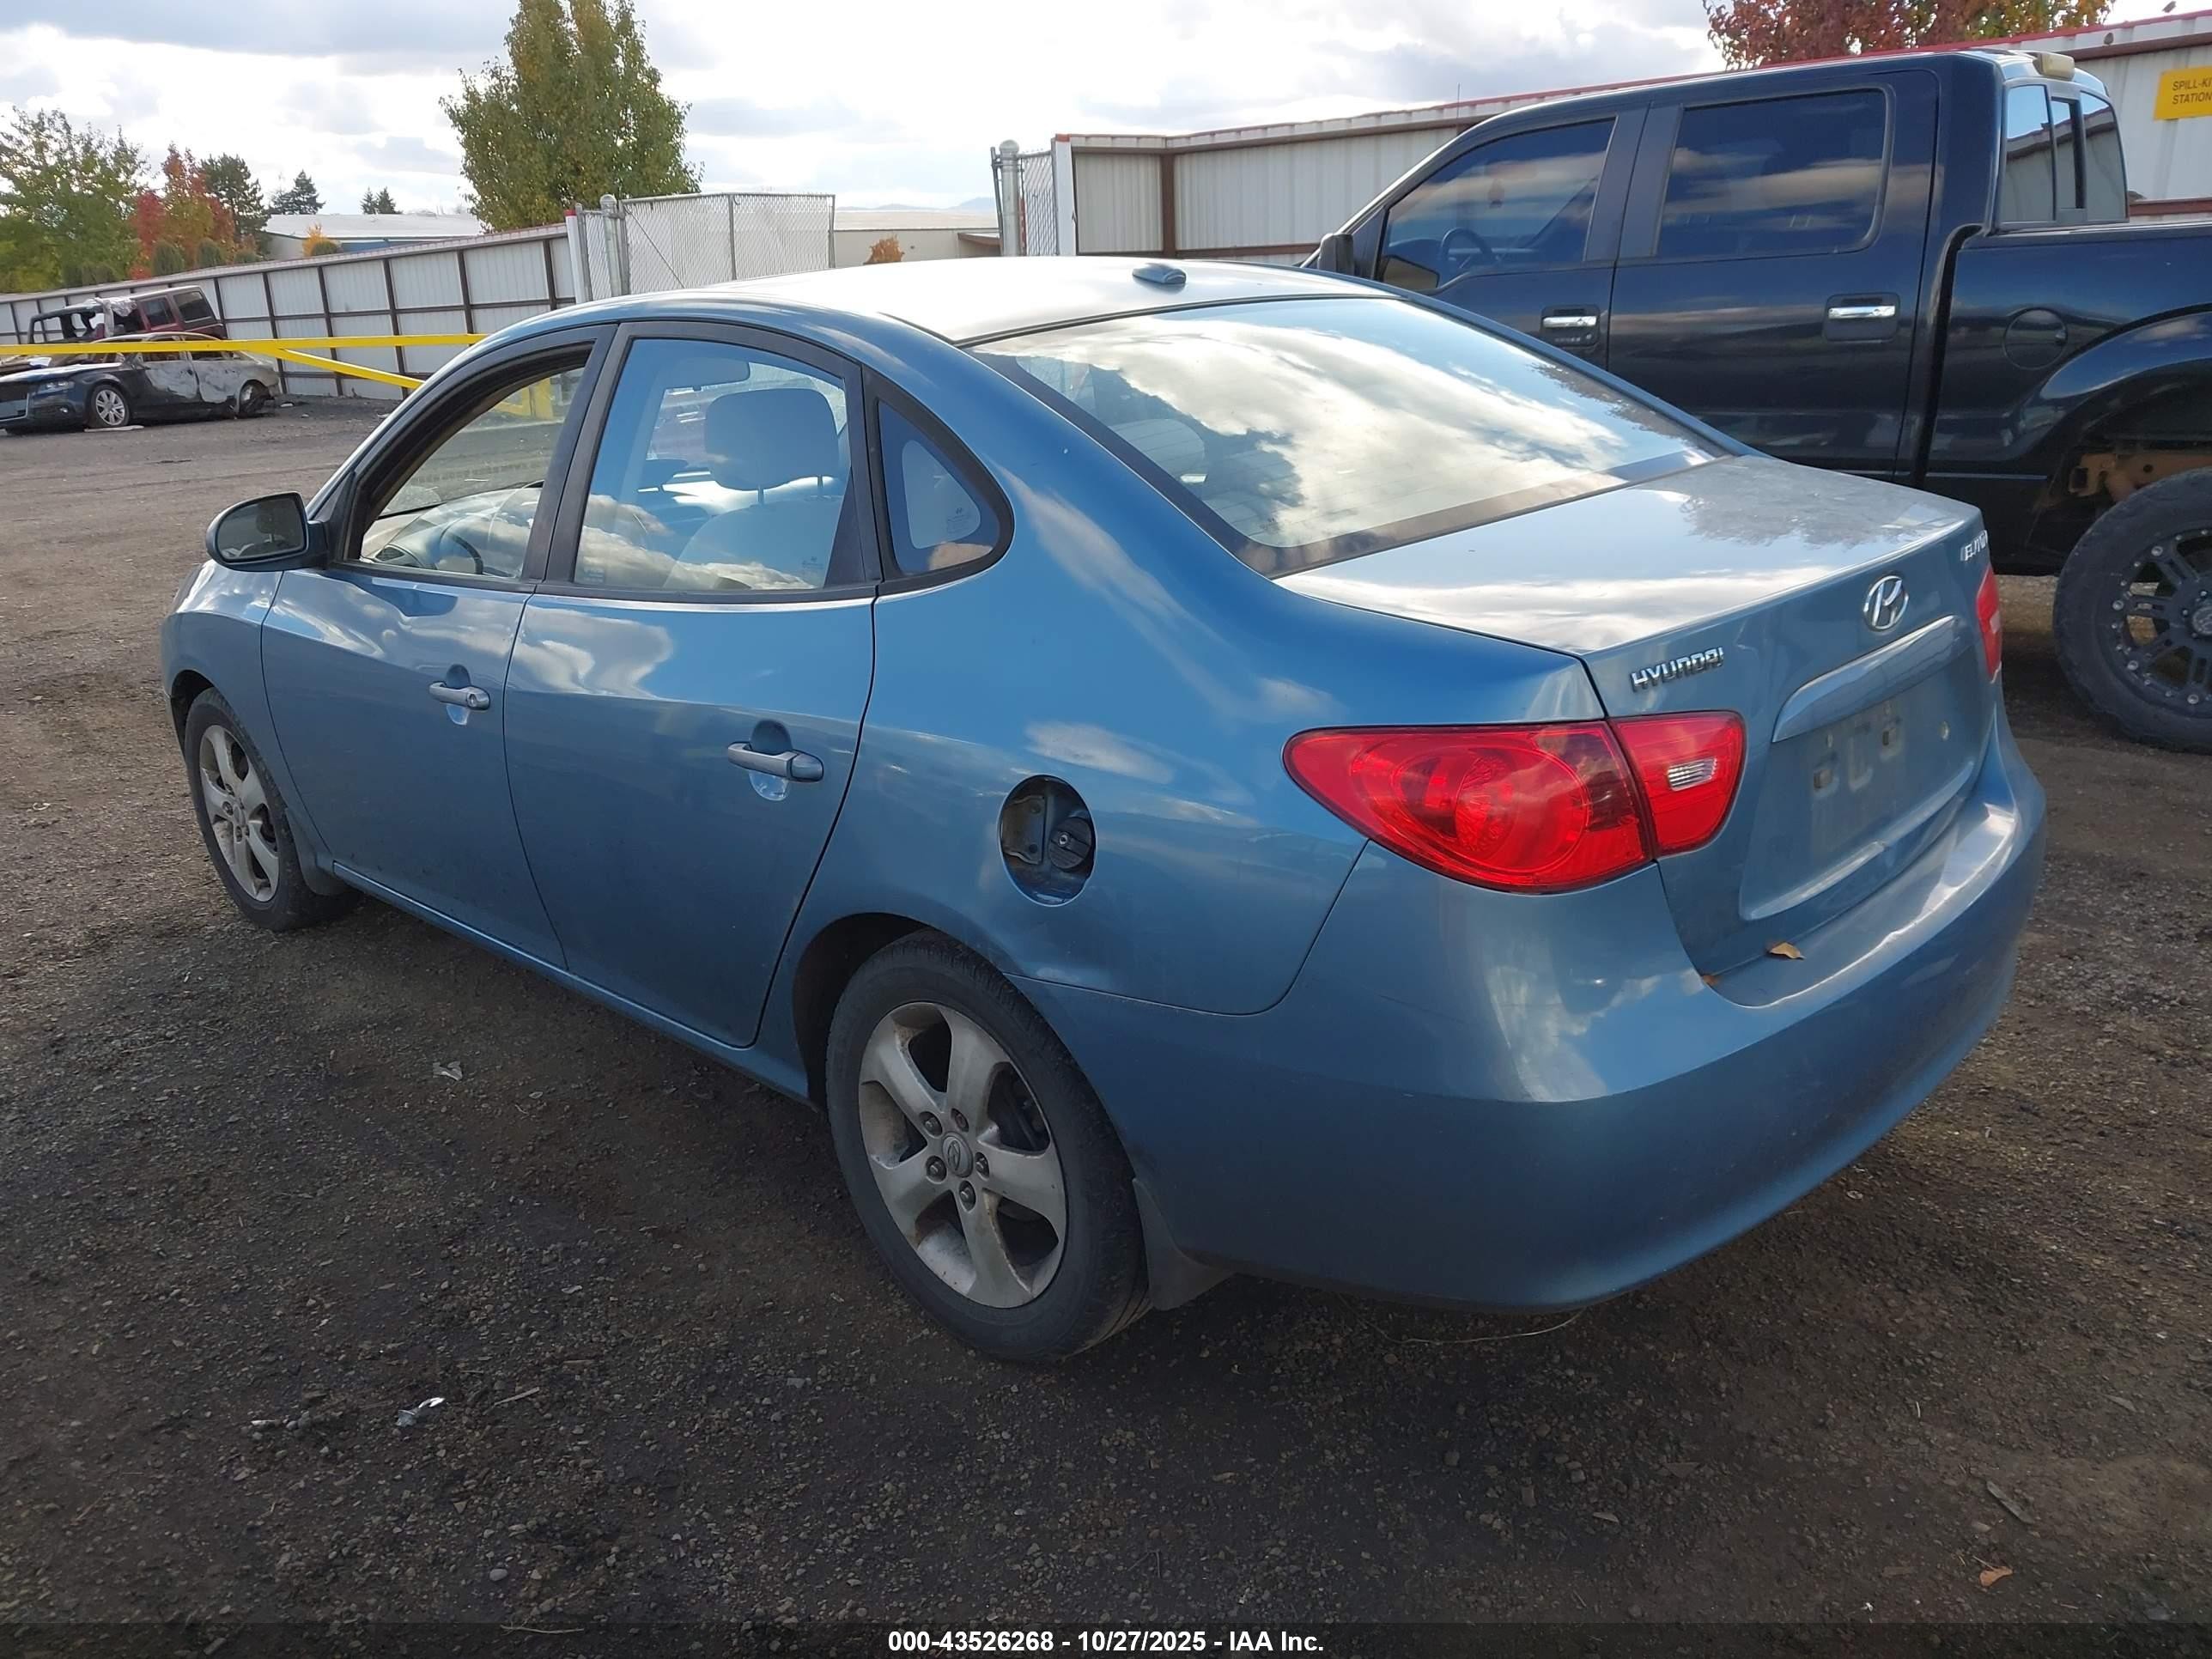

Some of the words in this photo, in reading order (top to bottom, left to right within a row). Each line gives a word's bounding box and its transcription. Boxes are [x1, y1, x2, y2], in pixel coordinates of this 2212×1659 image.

[2172, 77, 2212, 91] SPILL-KI
[2172, 92, 2212, 105] STATION
[1631, 647, 1724, 692] HYUNDAI
